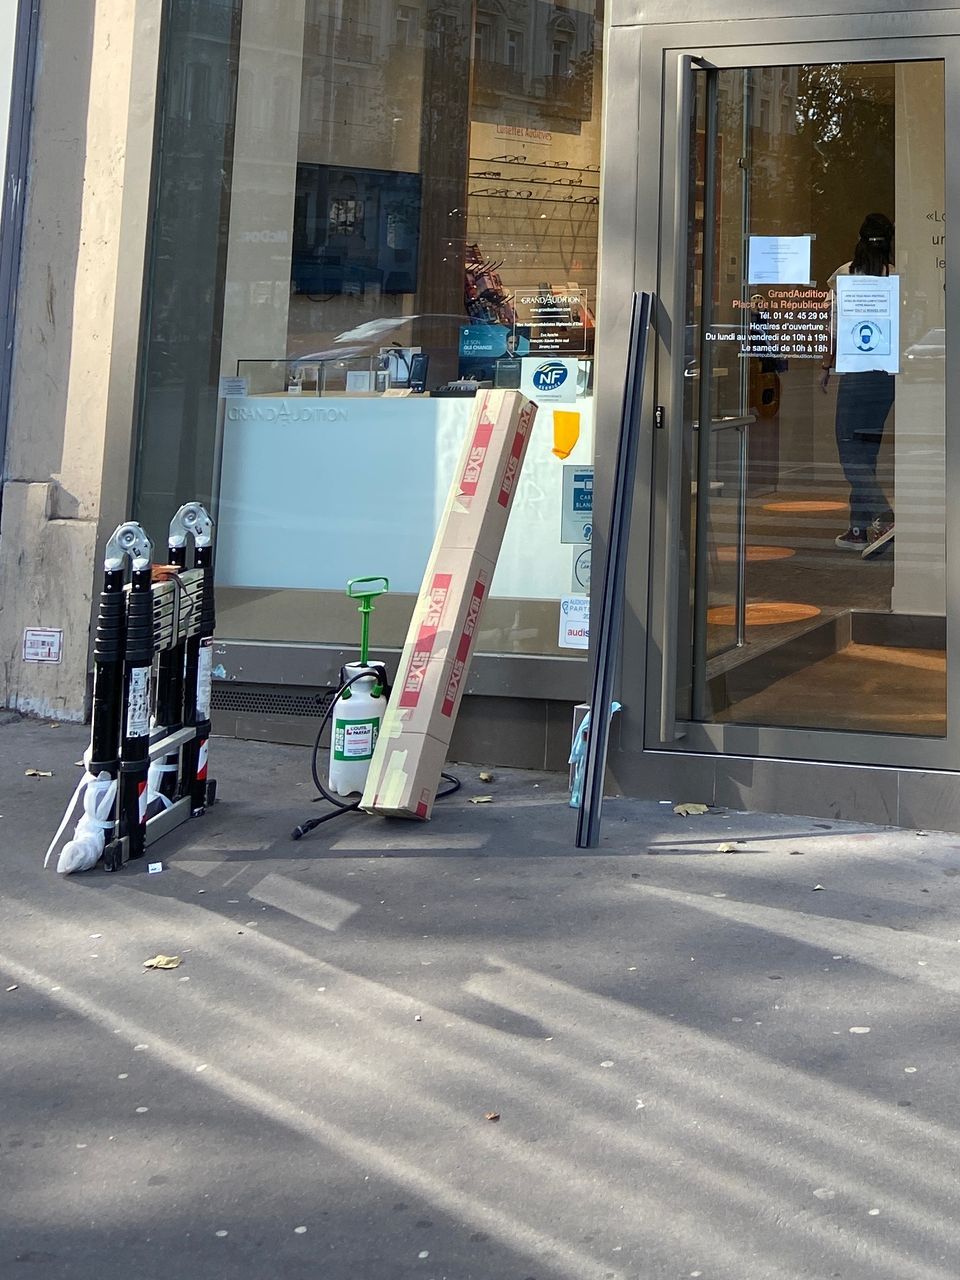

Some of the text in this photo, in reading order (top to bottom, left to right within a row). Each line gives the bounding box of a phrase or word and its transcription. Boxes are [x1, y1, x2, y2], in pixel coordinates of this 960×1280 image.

[732, 299, 829, 310] Place de la République
[768, 289, 829, 298] GrandAudition
[759, 311, 771, 319] Tél.
[747, 333, 779, 341] vendredi
[781, 333, 791, 341] de
[792, 333, 806, 341] 10h
[807, 333, 813, 341] à
[814, 333, 828, 341] 19h
[752, 344, 779, 352] samedi
[781, 344, 791, 352] de
[792, 344, 806, 352] 10h
[807, 344, 813, 352] à
[814, 344, 828, 352] 18h
[540, 370, 564, 384] NF
[463, 447, 487, 482] HEXIS
[501, 456, 519, 493] HEXIS
[424, 587, 447, 627] HEXIS
[463, 595, 481, 637] HEXIS
[405, 651, 430, 692] HEXIS
[446, 659, 465, 702] HEXIS
